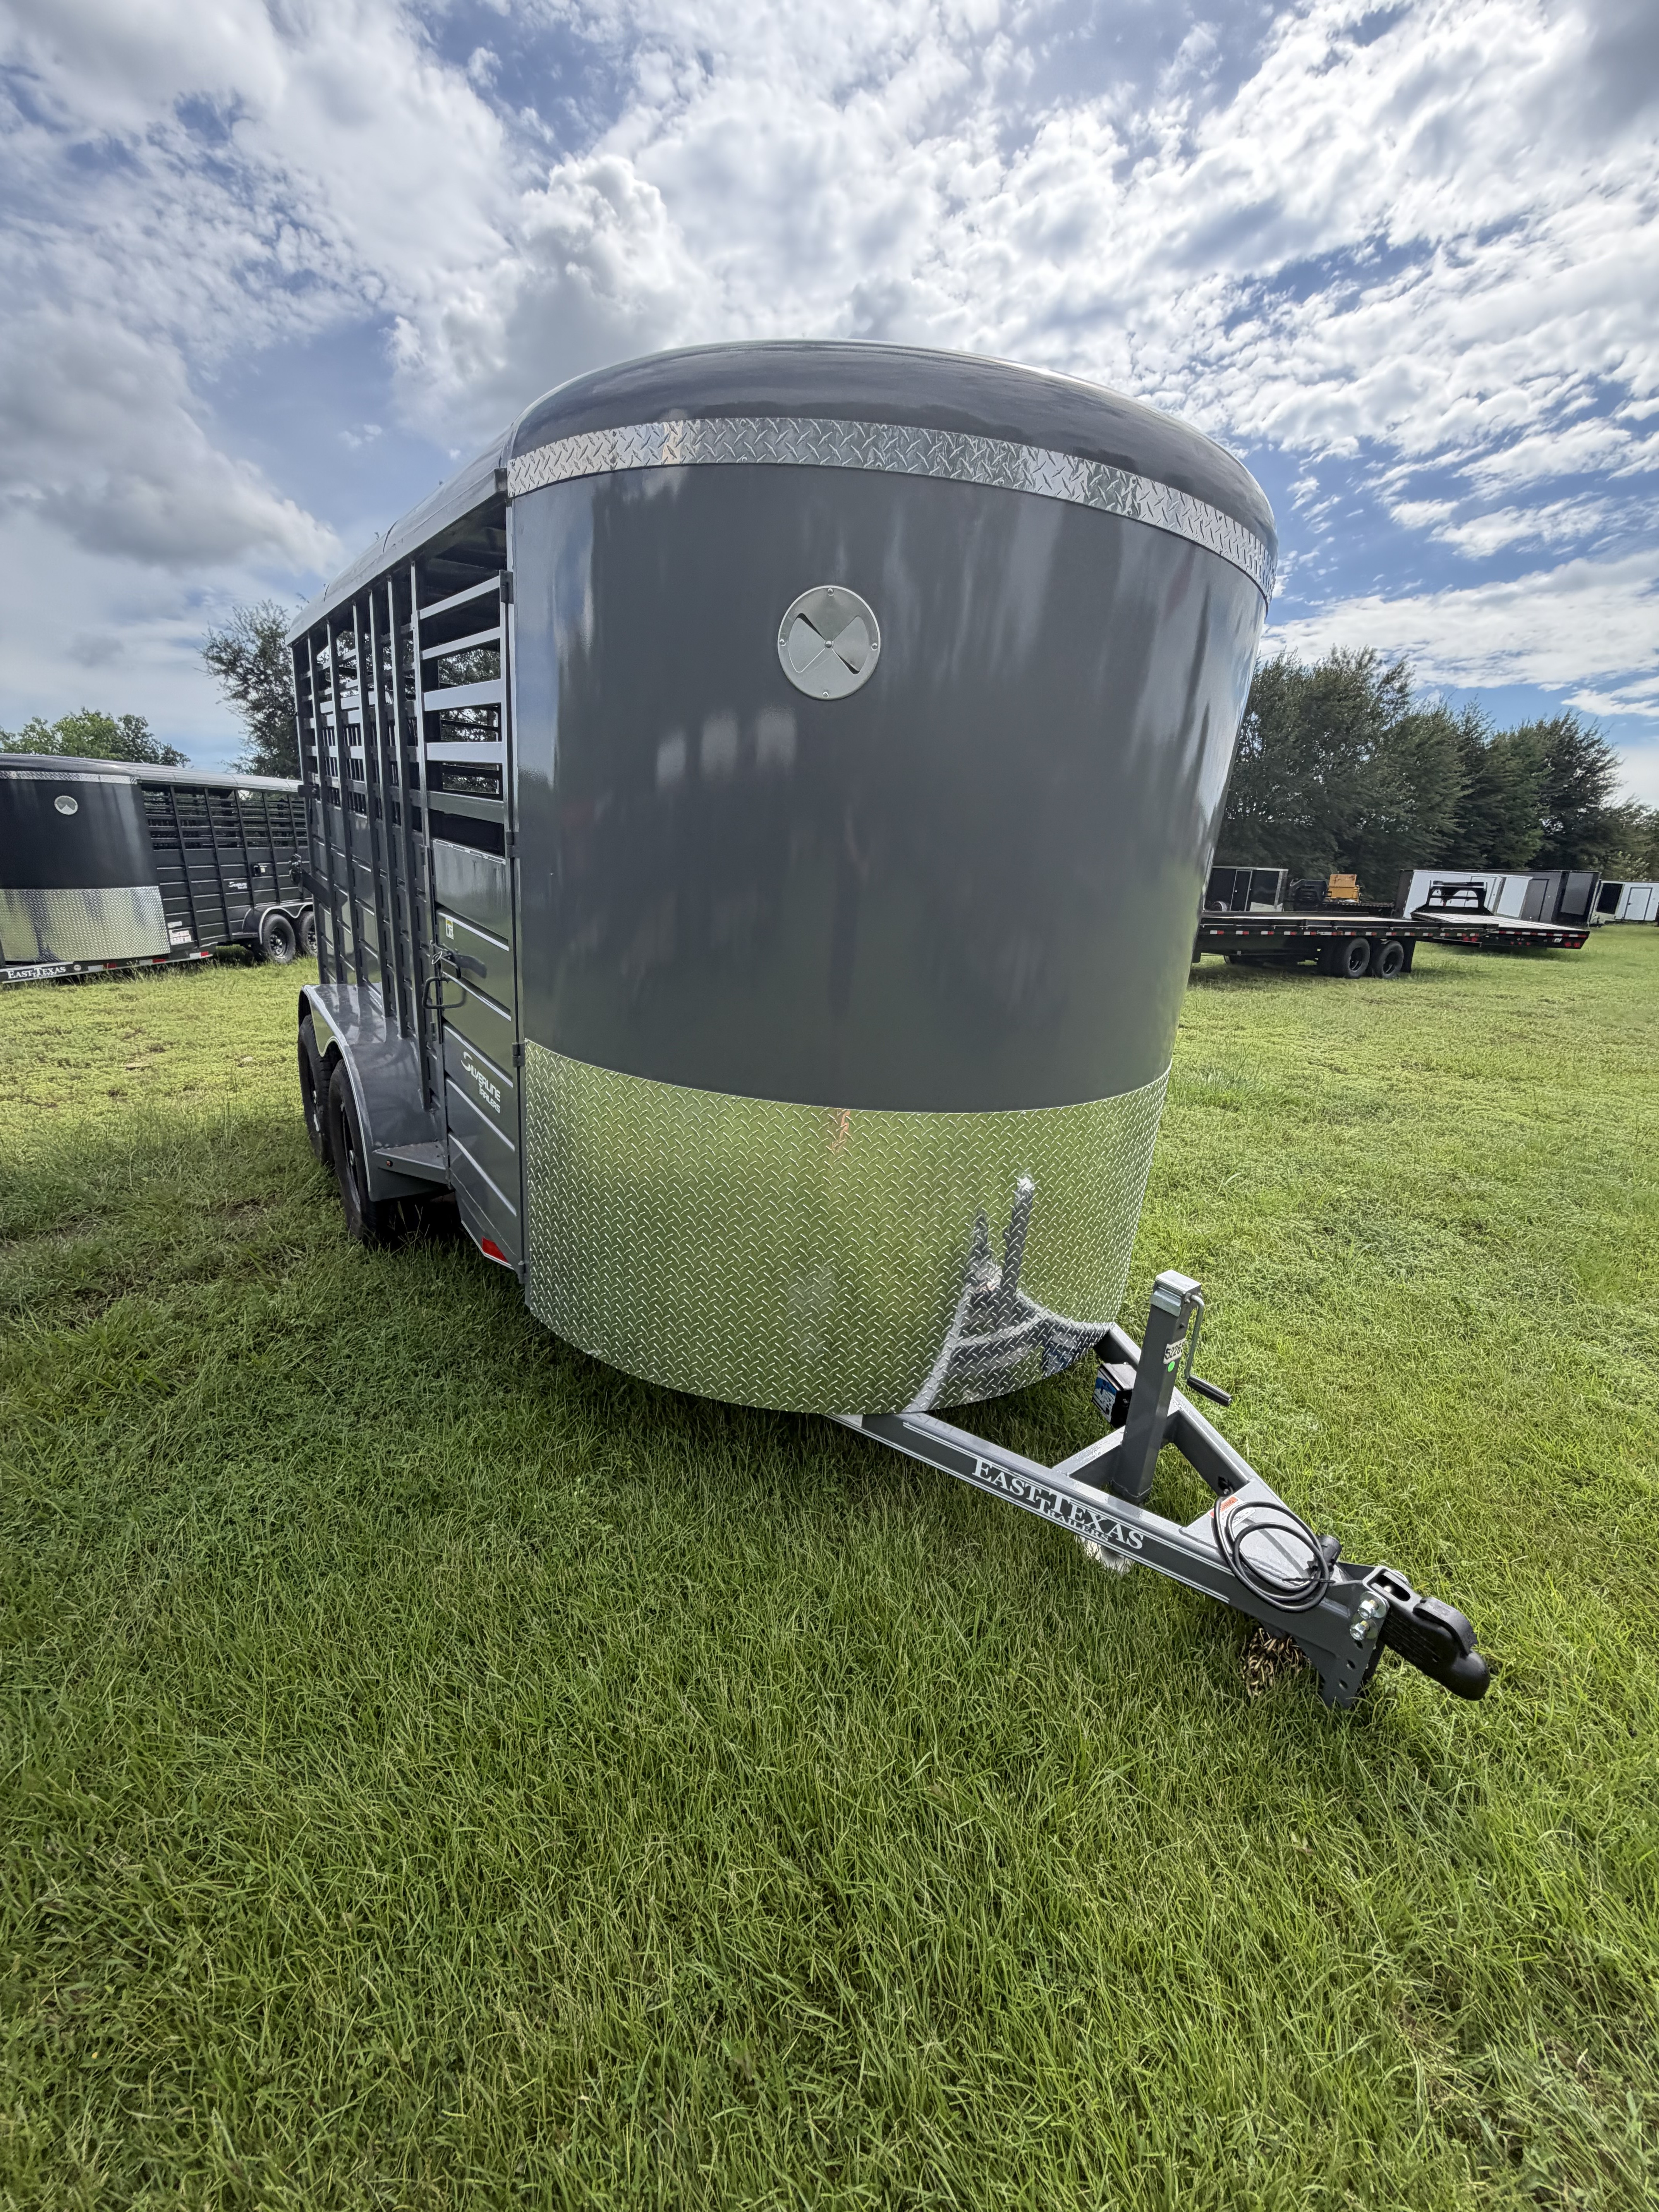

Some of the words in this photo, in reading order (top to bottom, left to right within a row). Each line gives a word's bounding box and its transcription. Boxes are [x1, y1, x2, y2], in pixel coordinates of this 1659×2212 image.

[7, 970, 33, 979] EAST
[34, 967, 66, 975] TEXAS
[461, 1051, 500, 1102] SILVERLINE
[479, 1083, 500, 1113] TRAILERS
[972, 1458, 1042, 1503] EAST
[1049, 1489, 1144, 1549] TEXAS
[1036, 1496, 1109, 1541] TRAILERS
